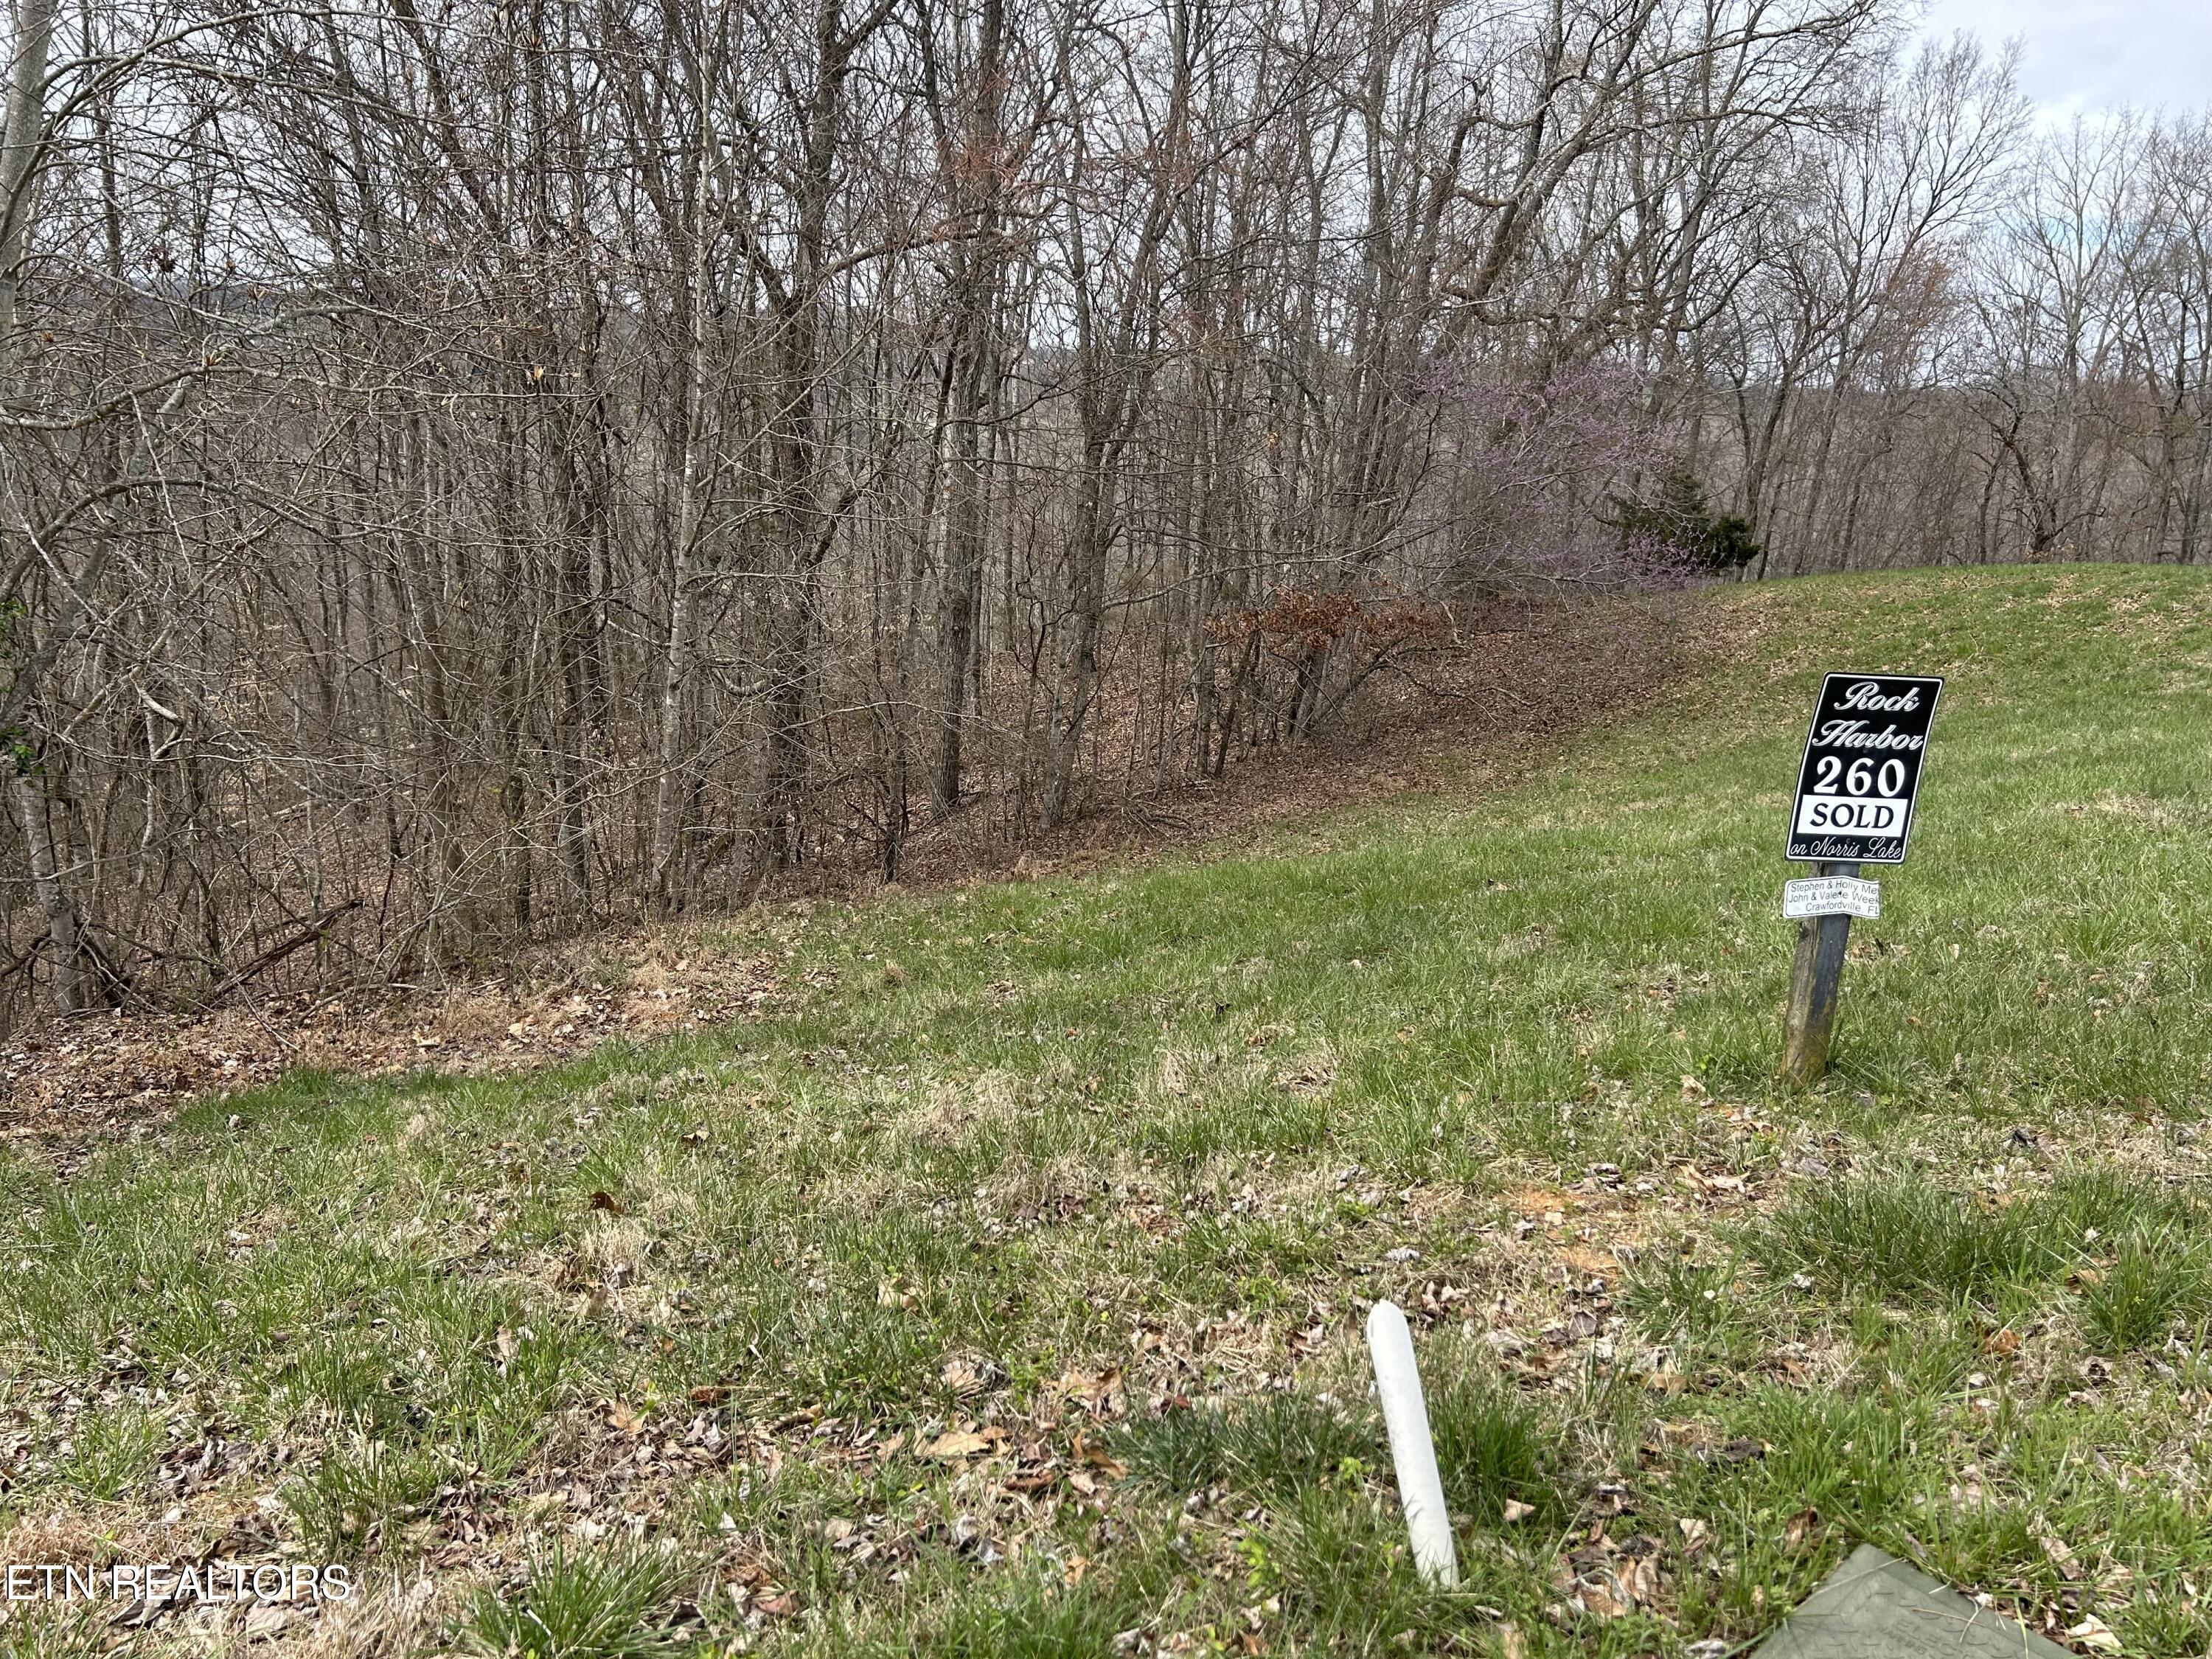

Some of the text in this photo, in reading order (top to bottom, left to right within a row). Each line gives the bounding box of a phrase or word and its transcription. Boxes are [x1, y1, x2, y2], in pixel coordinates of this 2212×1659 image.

[1834, 681, 1920, 712] Rock
[1812, 720, 1924, 751] Harbor
[1813, 756, 1905, 798] 260
[1809, 802, 1894, 830] SOLD
[1790, 836, 1902, 859] on Norris Lake
[1788, 893, 1809, 903] John
[1811, 891, 1818, 901] &
[1791, 882, 1824, 894] Stephen
[1827, 880, 1833, 889] &
[1835, 880, 1859, 893] Holly
